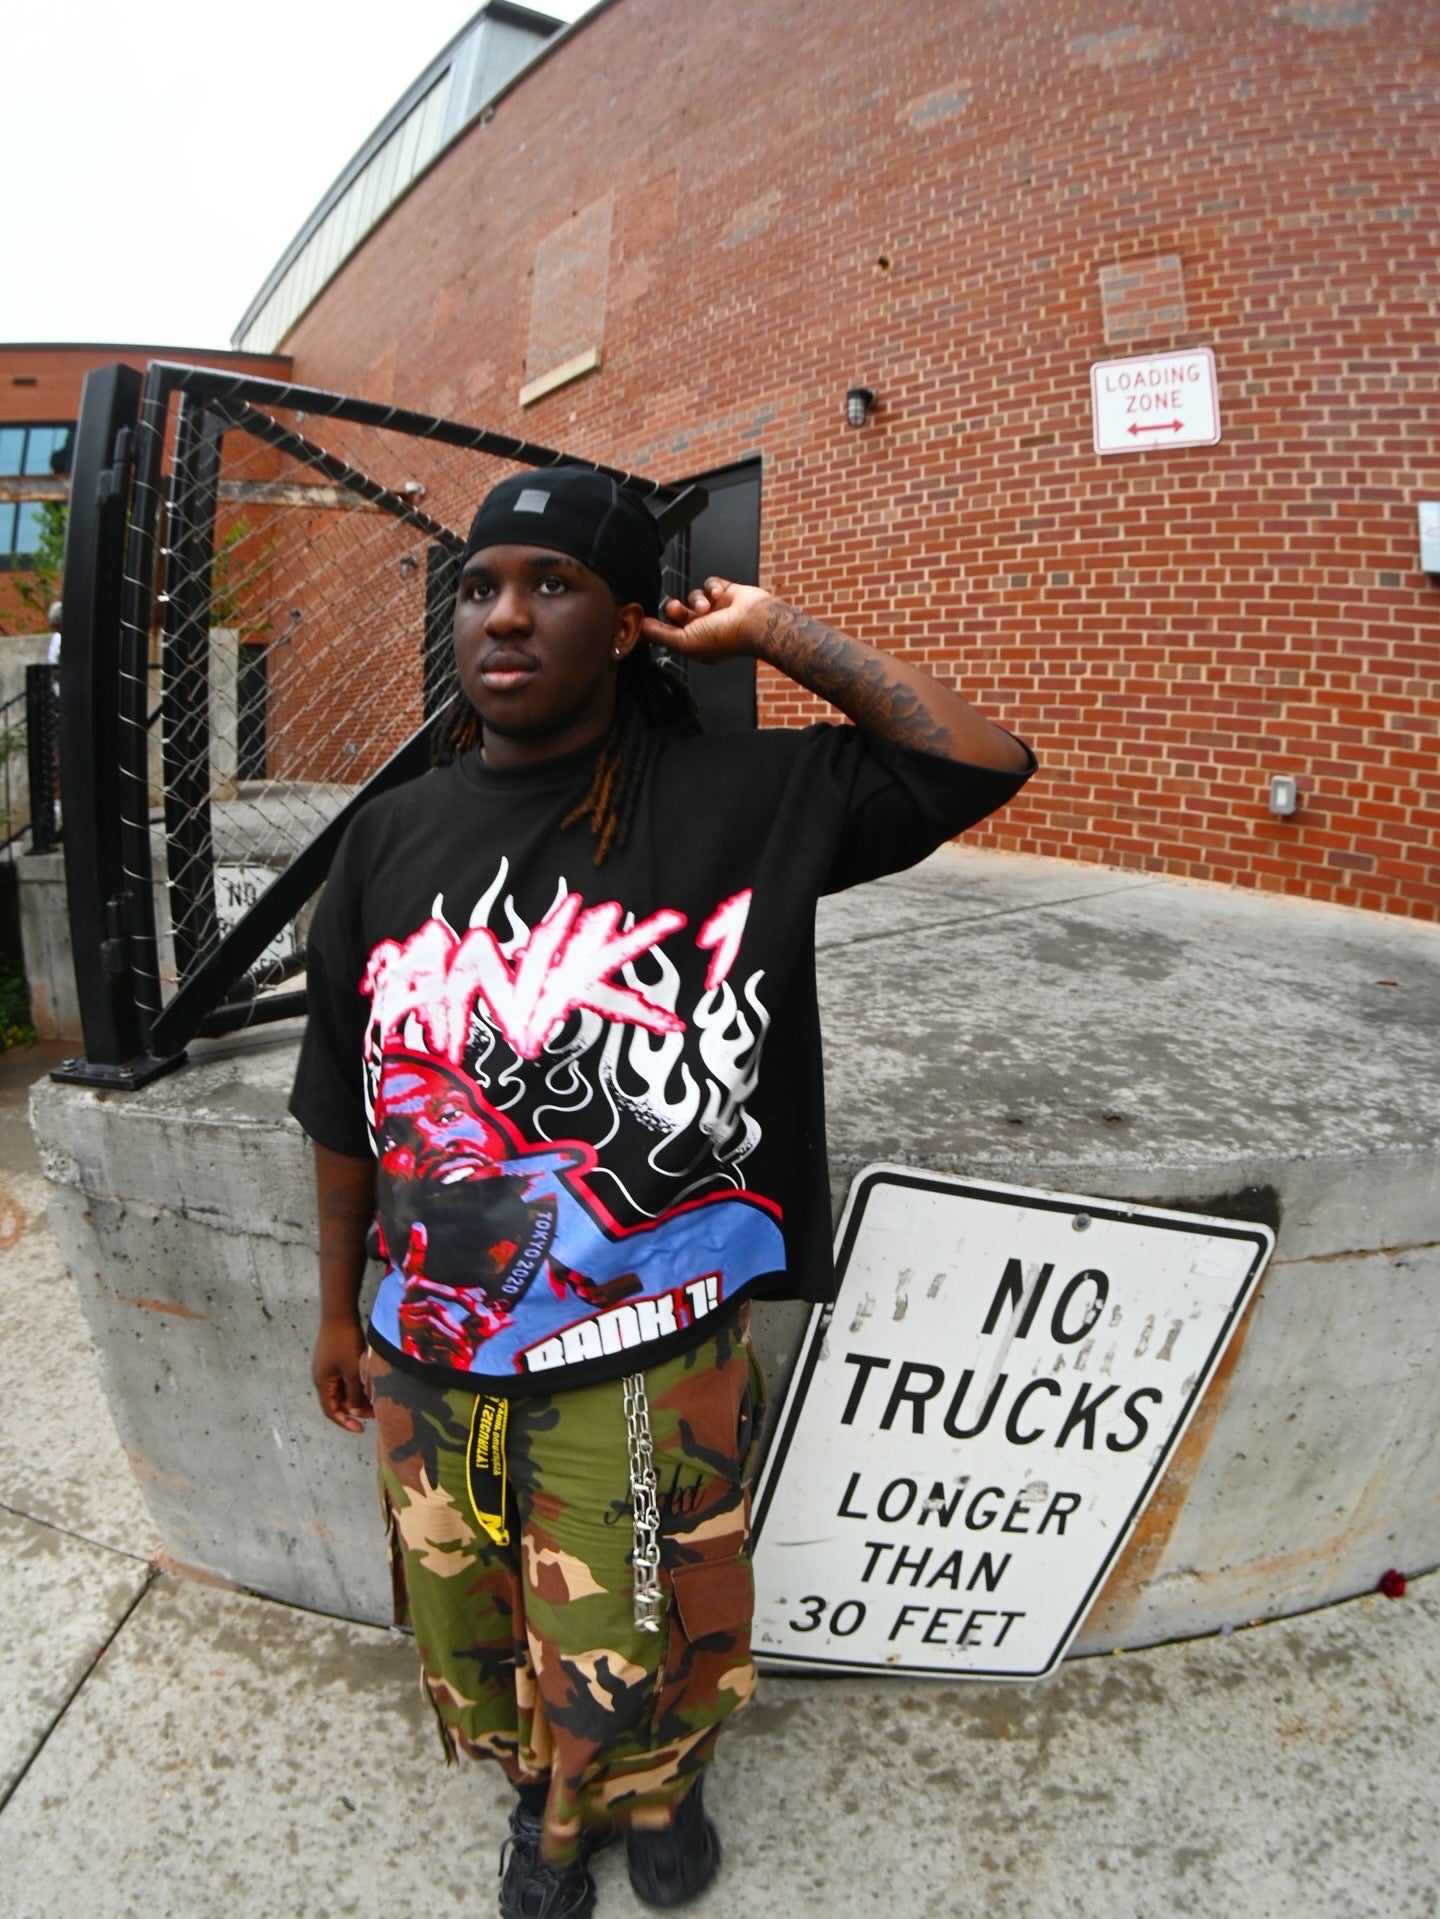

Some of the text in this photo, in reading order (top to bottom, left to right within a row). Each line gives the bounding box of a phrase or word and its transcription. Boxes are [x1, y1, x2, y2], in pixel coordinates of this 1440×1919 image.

[1105, 362, 1201, 393] LOADING
[1125, 388, 1184, 414] ZONE
[695, 887, 753, 993] 1
[501, 1211, 553, 1295] TOKYO 2020
[685, 1275, 719, 1320] 1!
[980, 1257, 1110, 1345] NO
[839, 1352, 1164, 1453] TRUCKS
[836, 1471, 1083, 1536] LONGER
[860, 1541, 1013, 1592] THAN
[788, 1595, 1027, 1648] 30 FEET
